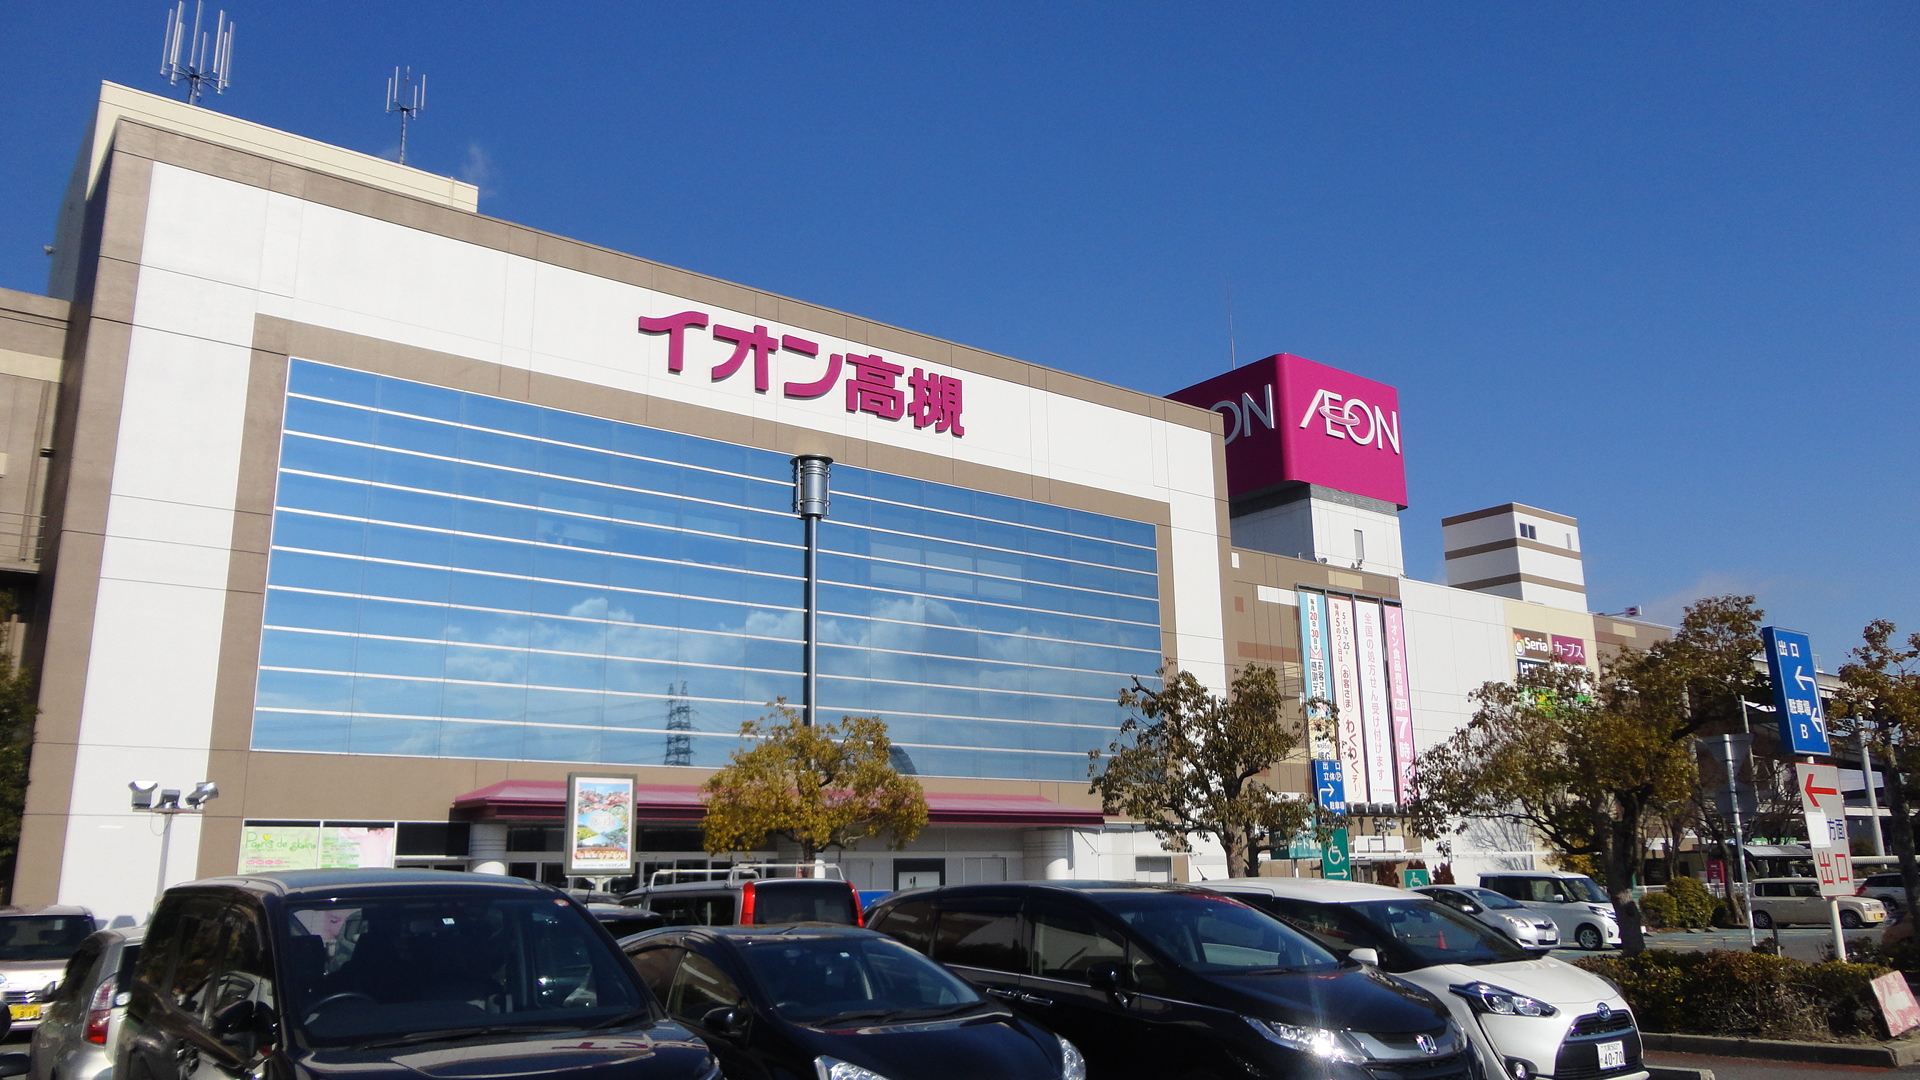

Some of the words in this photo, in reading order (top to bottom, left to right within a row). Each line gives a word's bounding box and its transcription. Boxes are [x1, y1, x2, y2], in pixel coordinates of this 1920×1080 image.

[639, 311, 964, 436] イオン高槻
[1524, 637, 1548, 652] Seria
[1778, 640, 1799, 658] 出口
[1342, 669, 1351, 708] お客さま
[1363, 612, 1384, 781] 全国の処方せん受け付けます
[1788, 698, 1811, 716] 駐車場
[1800, 723, 1809, 739] B
[1345, 720, 1359, 792] わくわくデー
[1322, 762, 1341, 771] 出口
[245, 831, 274, 849] Paris
[276, 837, 288, 848] de
[1817, 852, 1849, 885] 出口
